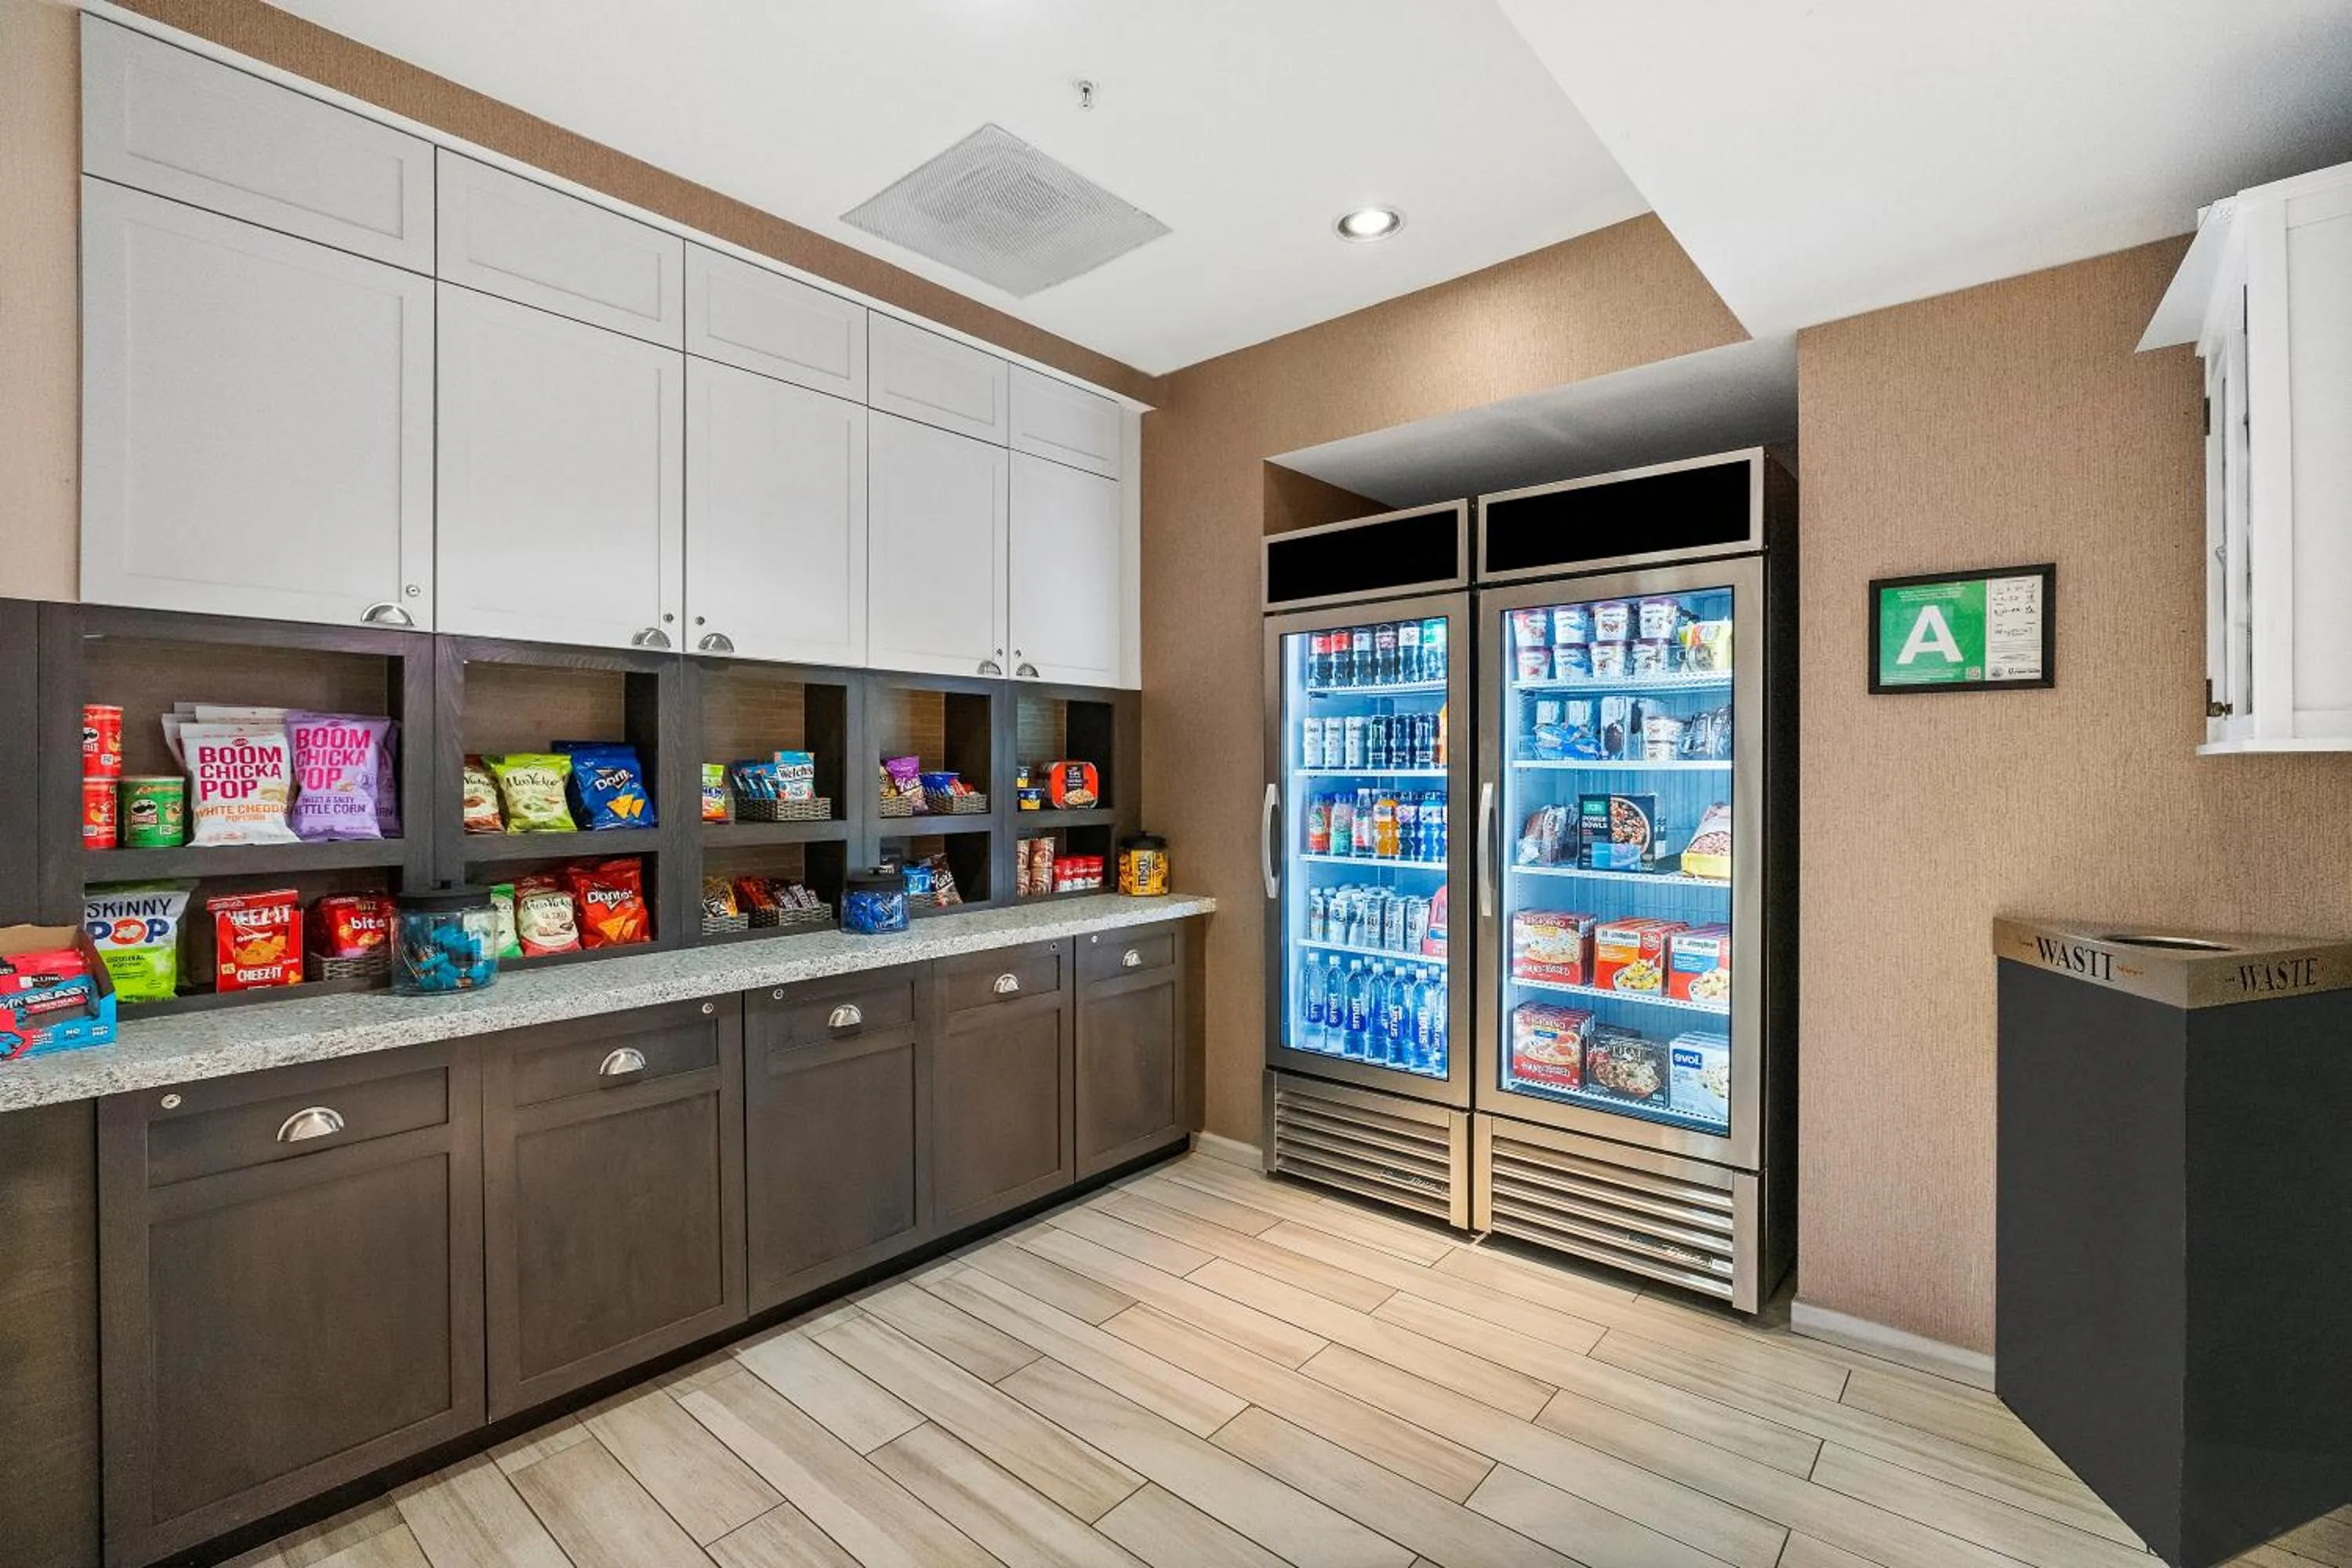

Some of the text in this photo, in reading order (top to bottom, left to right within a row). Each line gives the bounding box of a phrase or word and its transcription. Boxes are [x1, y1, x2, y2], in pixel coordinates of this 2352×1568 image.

[1896, 604, 1963, 665] A
[296, 727, 372, 750] BOOM
[199, 746, 283, 764] BOOM
[296, 748, 366, 768] CHICKA
[200, 764, 282, 780] CHICKA
[298, 767, 343, 791] POP
[778, 766, 813, 779] Welch's
[200, 779, 258, 801] POP
[334, 804, 366, 815] CORN
[86, 898, 172, 918] SKINNY
[85, 918, 170, 945] POP
[237, 966, 282, 982] CHEEZ-IT
[2240, 957, 2319, 992] WASTE
[1352, 997, 1362, 1030] smart
